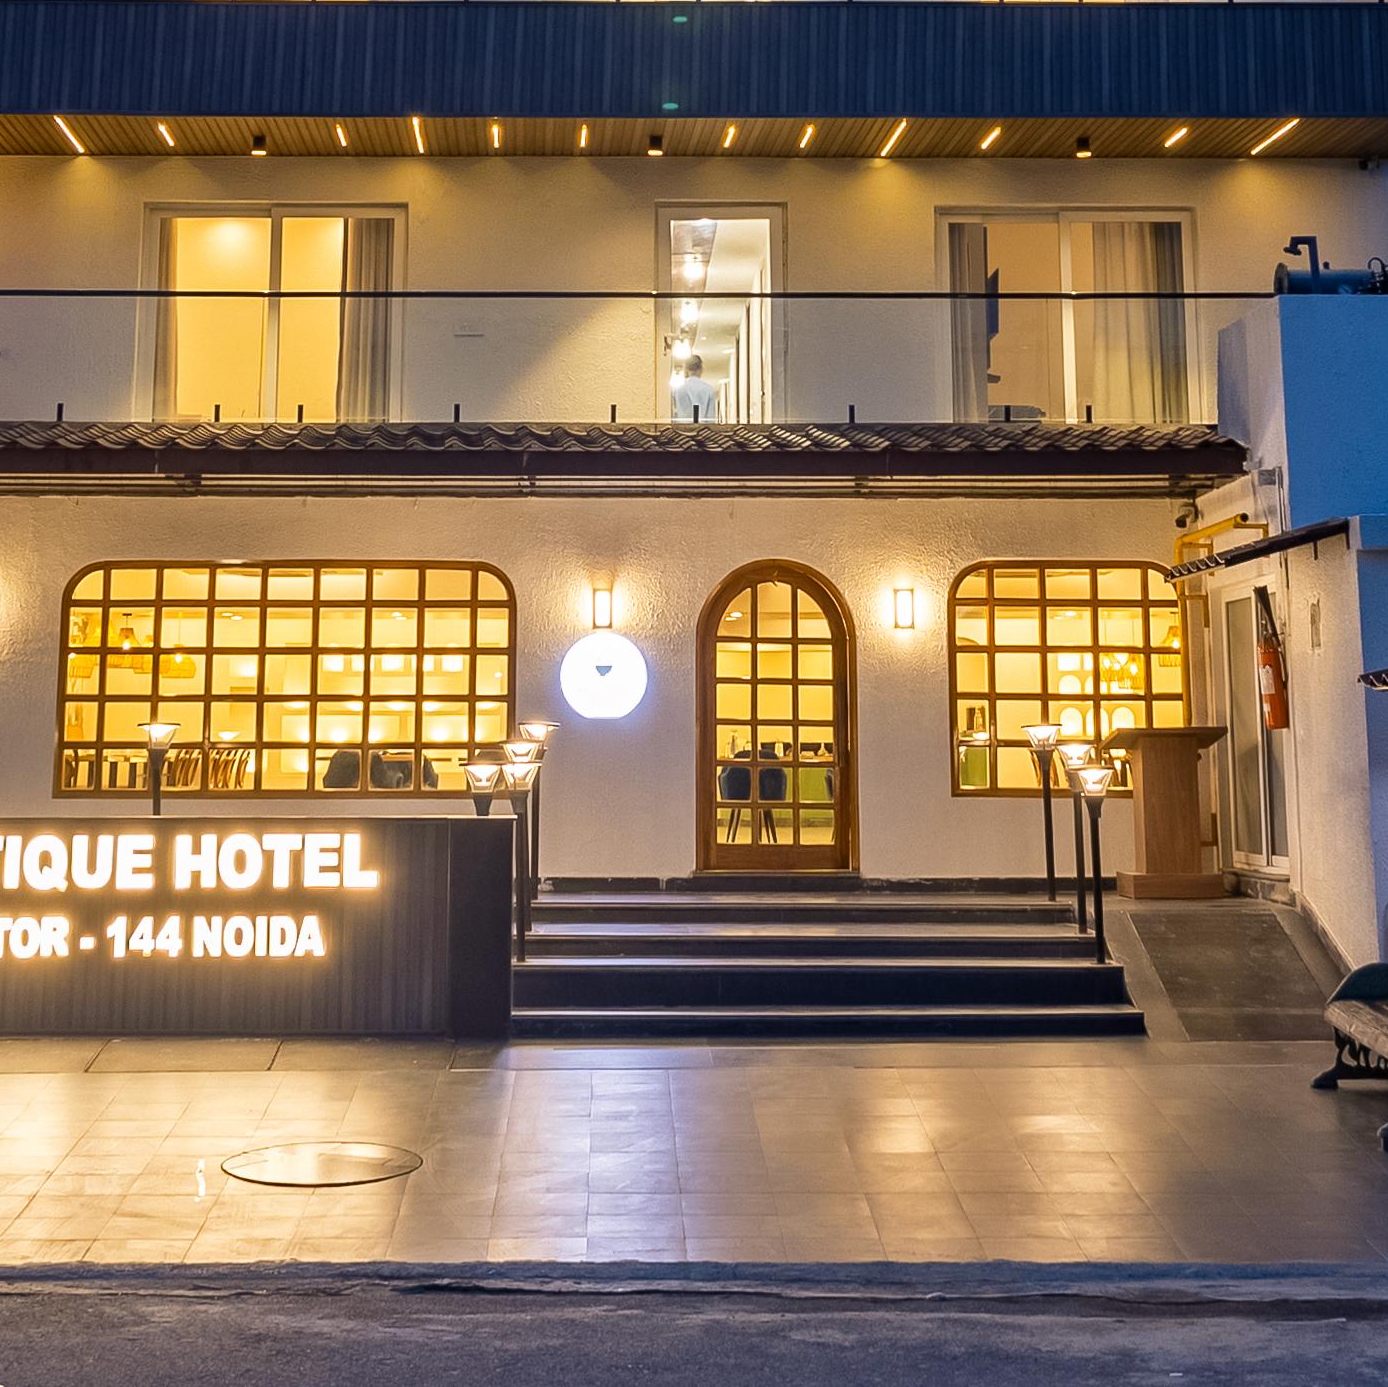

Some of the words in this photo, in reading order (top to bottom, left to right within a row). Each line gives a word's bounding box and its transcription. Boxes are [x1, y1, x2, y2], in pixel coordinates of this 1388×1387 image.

[173, 832, 379, 890] HOTEL
[105, 914, 183, 959] 144
[191, 914, 327, 959] NOIDA
